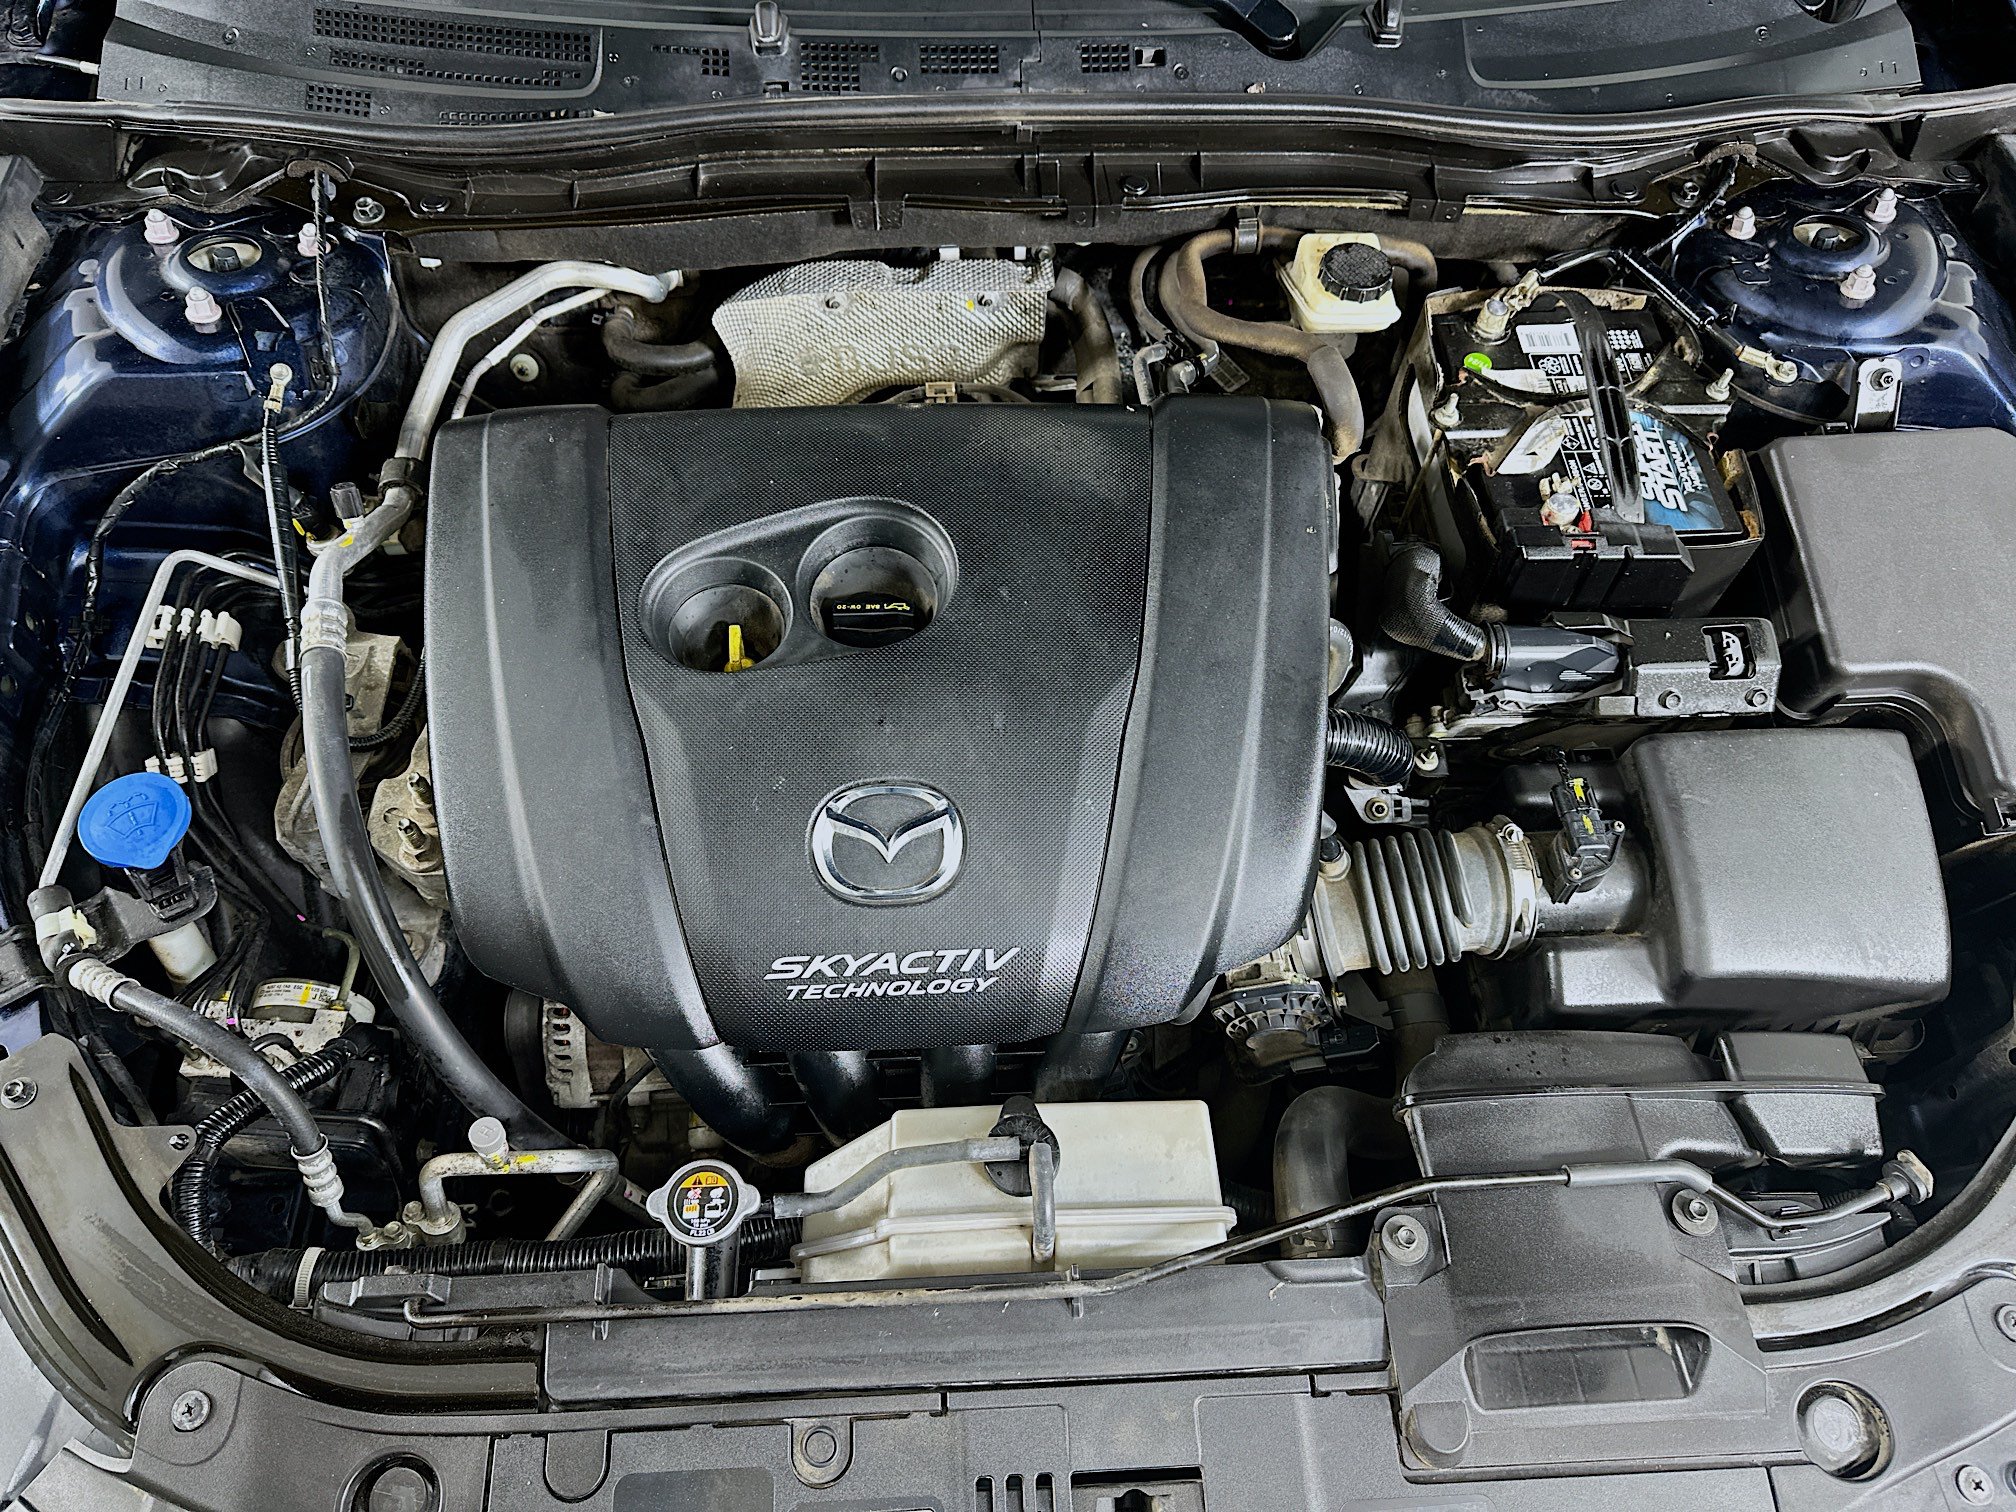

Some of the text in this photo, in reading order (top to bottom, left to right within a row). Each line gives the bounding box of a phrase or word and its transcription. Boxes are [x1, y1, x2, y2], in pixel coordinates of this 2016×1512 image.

[1631, 423, 1656, 500] SUP
[1634, 422, 1688, 512] START
[1666, 439, 1696, 495] PLATINUM
[763, 947, 1021, 981] SKYACTIV
[786, 976, 1000, 1000] TECHNOLOGY
